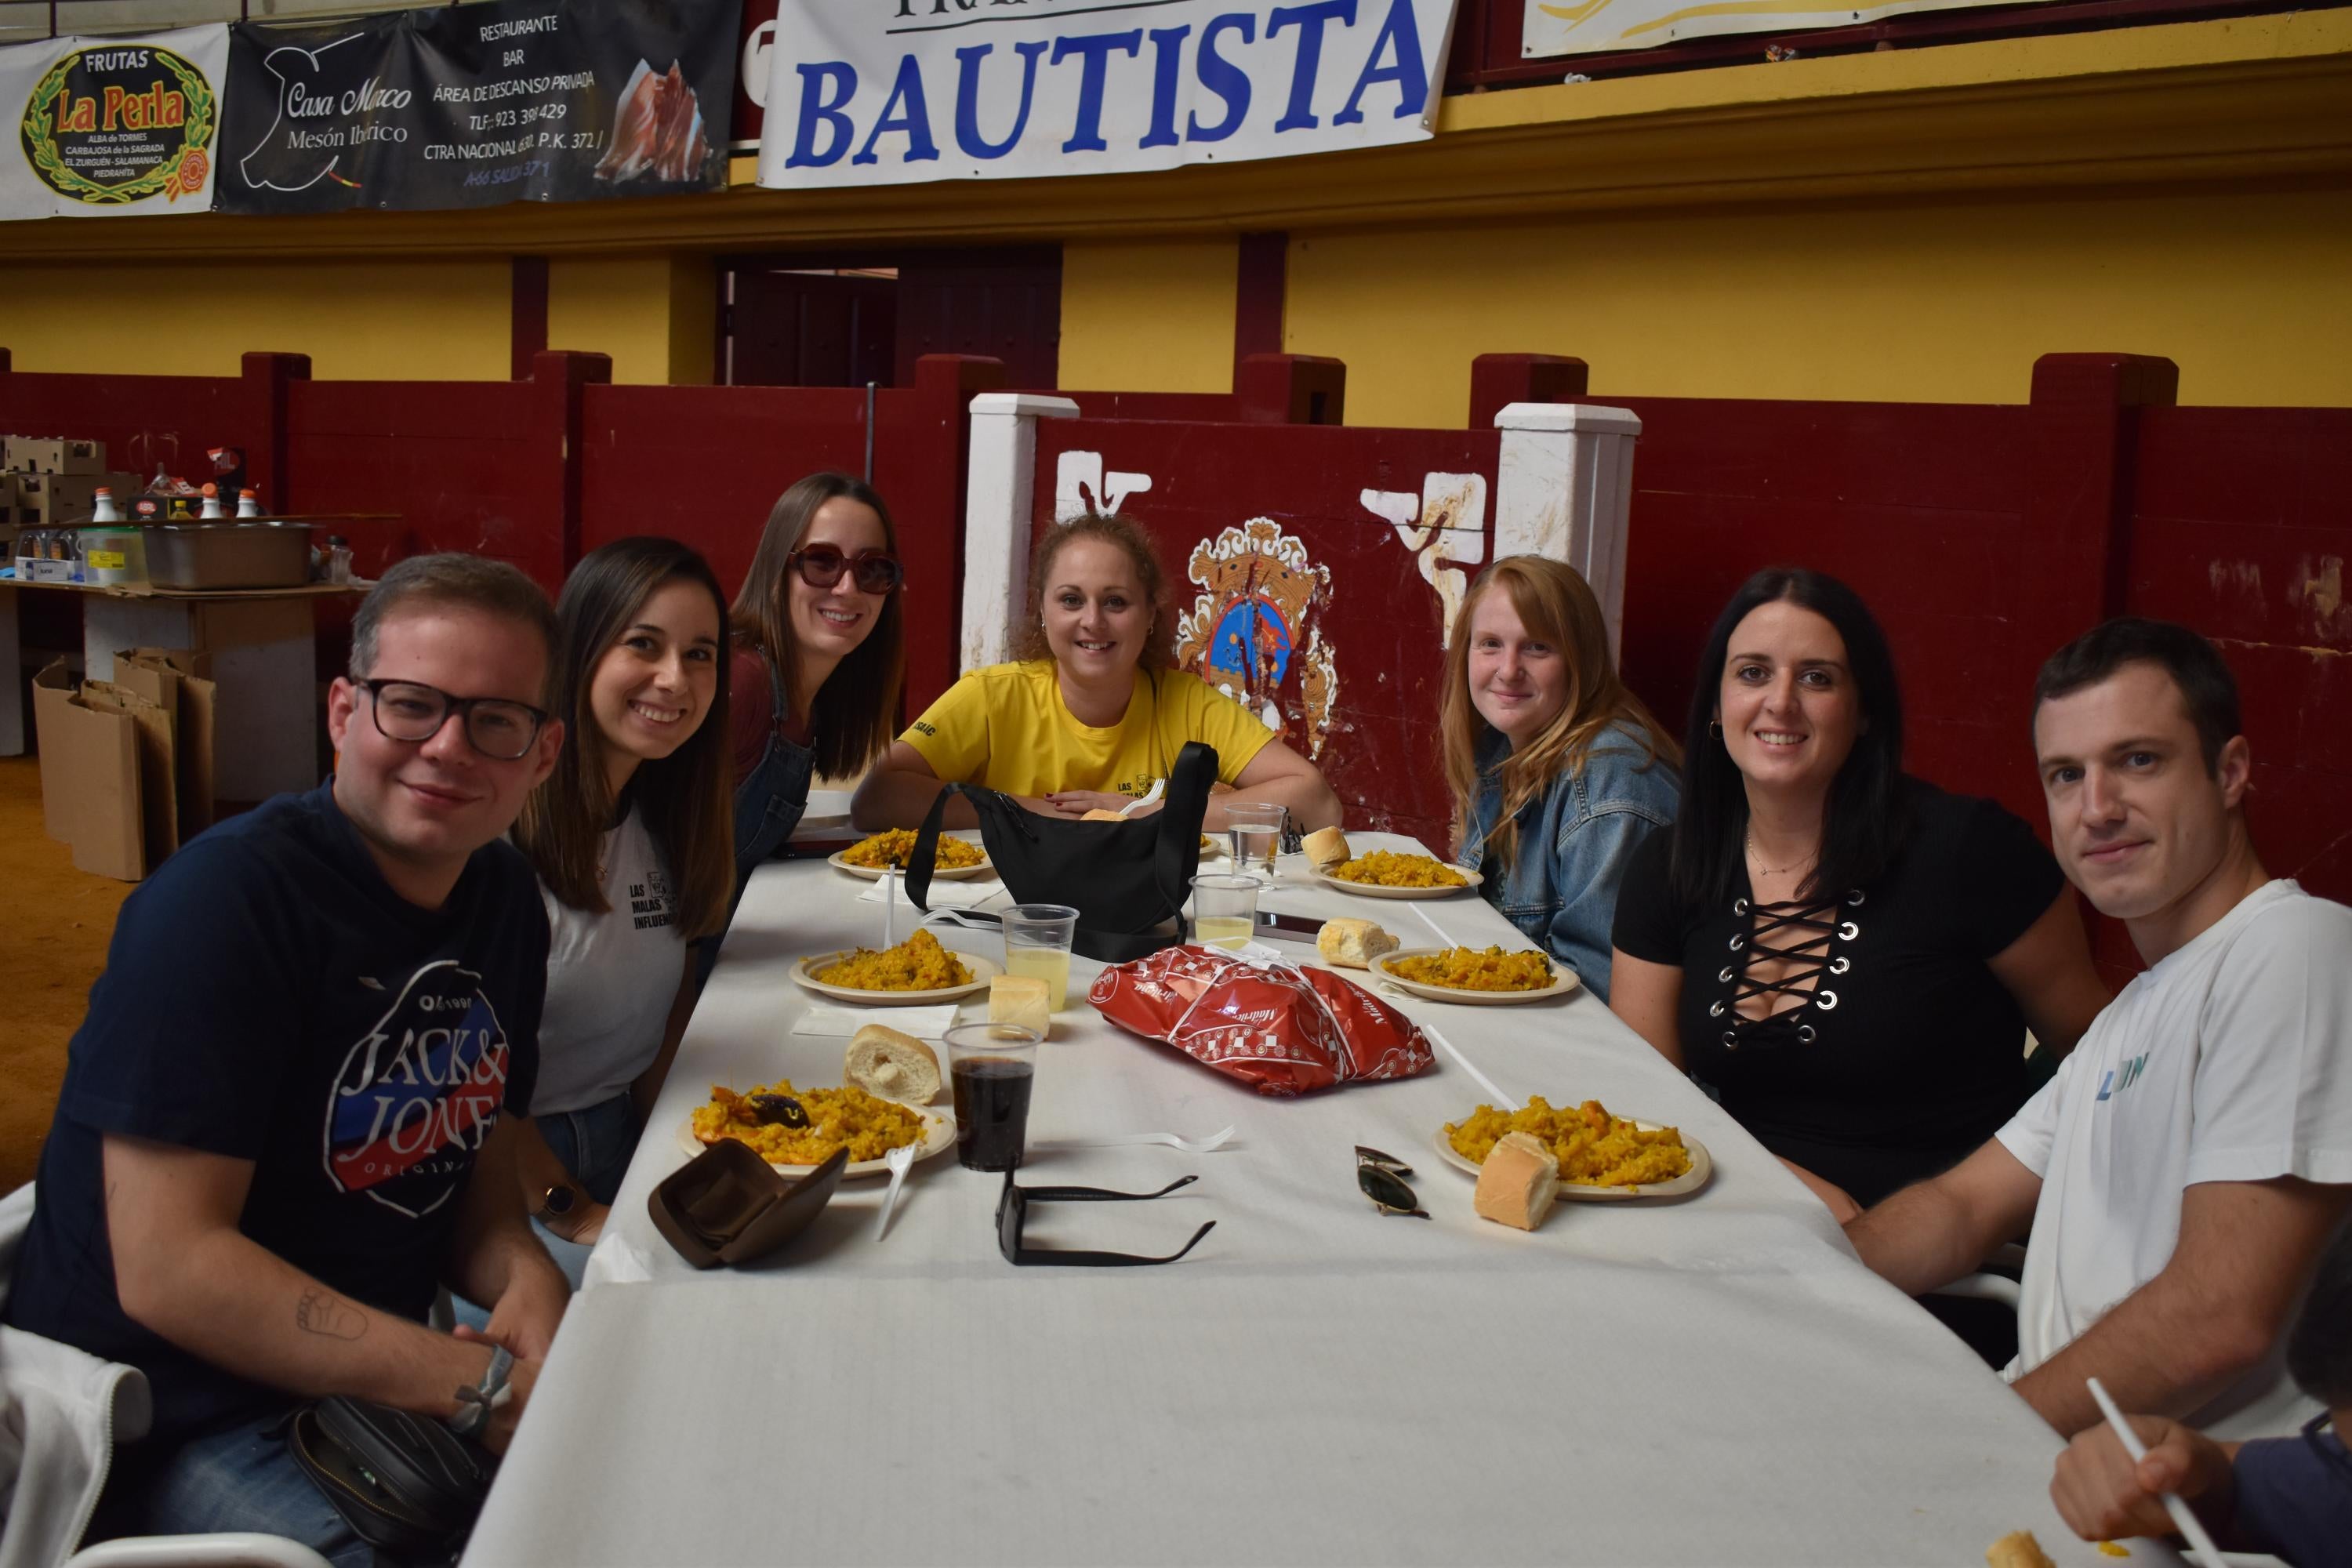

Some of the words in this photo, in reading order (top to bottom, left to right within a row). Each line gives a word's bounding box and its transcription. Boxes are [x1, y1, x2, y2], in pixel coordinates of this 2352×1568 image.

[480, 15, 558, 42] RESTAURANTE
[85, 50, 149, 73] FRUTAS
[503, 49, 524, 67] BAR
[433, 83, 470, 102] ÁREA
[473, 86, 488, 102] DE
[489, 77, 550, 100] DESCANSO
[551, 71, 596, 90] PRIVADA
[785, 0, 1429, 169] BAUTISTA
[56, 88, 96, 132] La
[103, 80, 185, 130] Perla
[288, 82, 335, 118] Casa
[495, 110, 516, 126] 923
[539, 103, 567, 119] 429
[88, 134, 107, 143] ALBA
[108, 133, 117, 143] de
[118, 132, 147, 142] TORMES
[287, 127, 345, 149] Mesón
[424, 145, 456, 159] CTRA
[459, 140, 517, 160] NACIONAL
[538, 132, 567, 149] P.K.
[571, 132, 594, 149] 372
[65, 146, 112, 155] CARBAJOSA
[113, 145, 122, 154] de
[122, 145, 130, 154] la
[131, 144, 165, 154] SAGRADA
[65, 158, 75, 166] EL
[75, 156, 111, 166] ZURGUÉN
[93, 168, 136, 178] PIEDRAHÍTA
[1117, 782, 1131, 791] LAS
[630, 884, 644, 898] LAS
[631, 899, 662, 914] MALAS
[337, 1095, 498, 1163] JONE
[365, 1160, 464, 1177] ORIGIN
